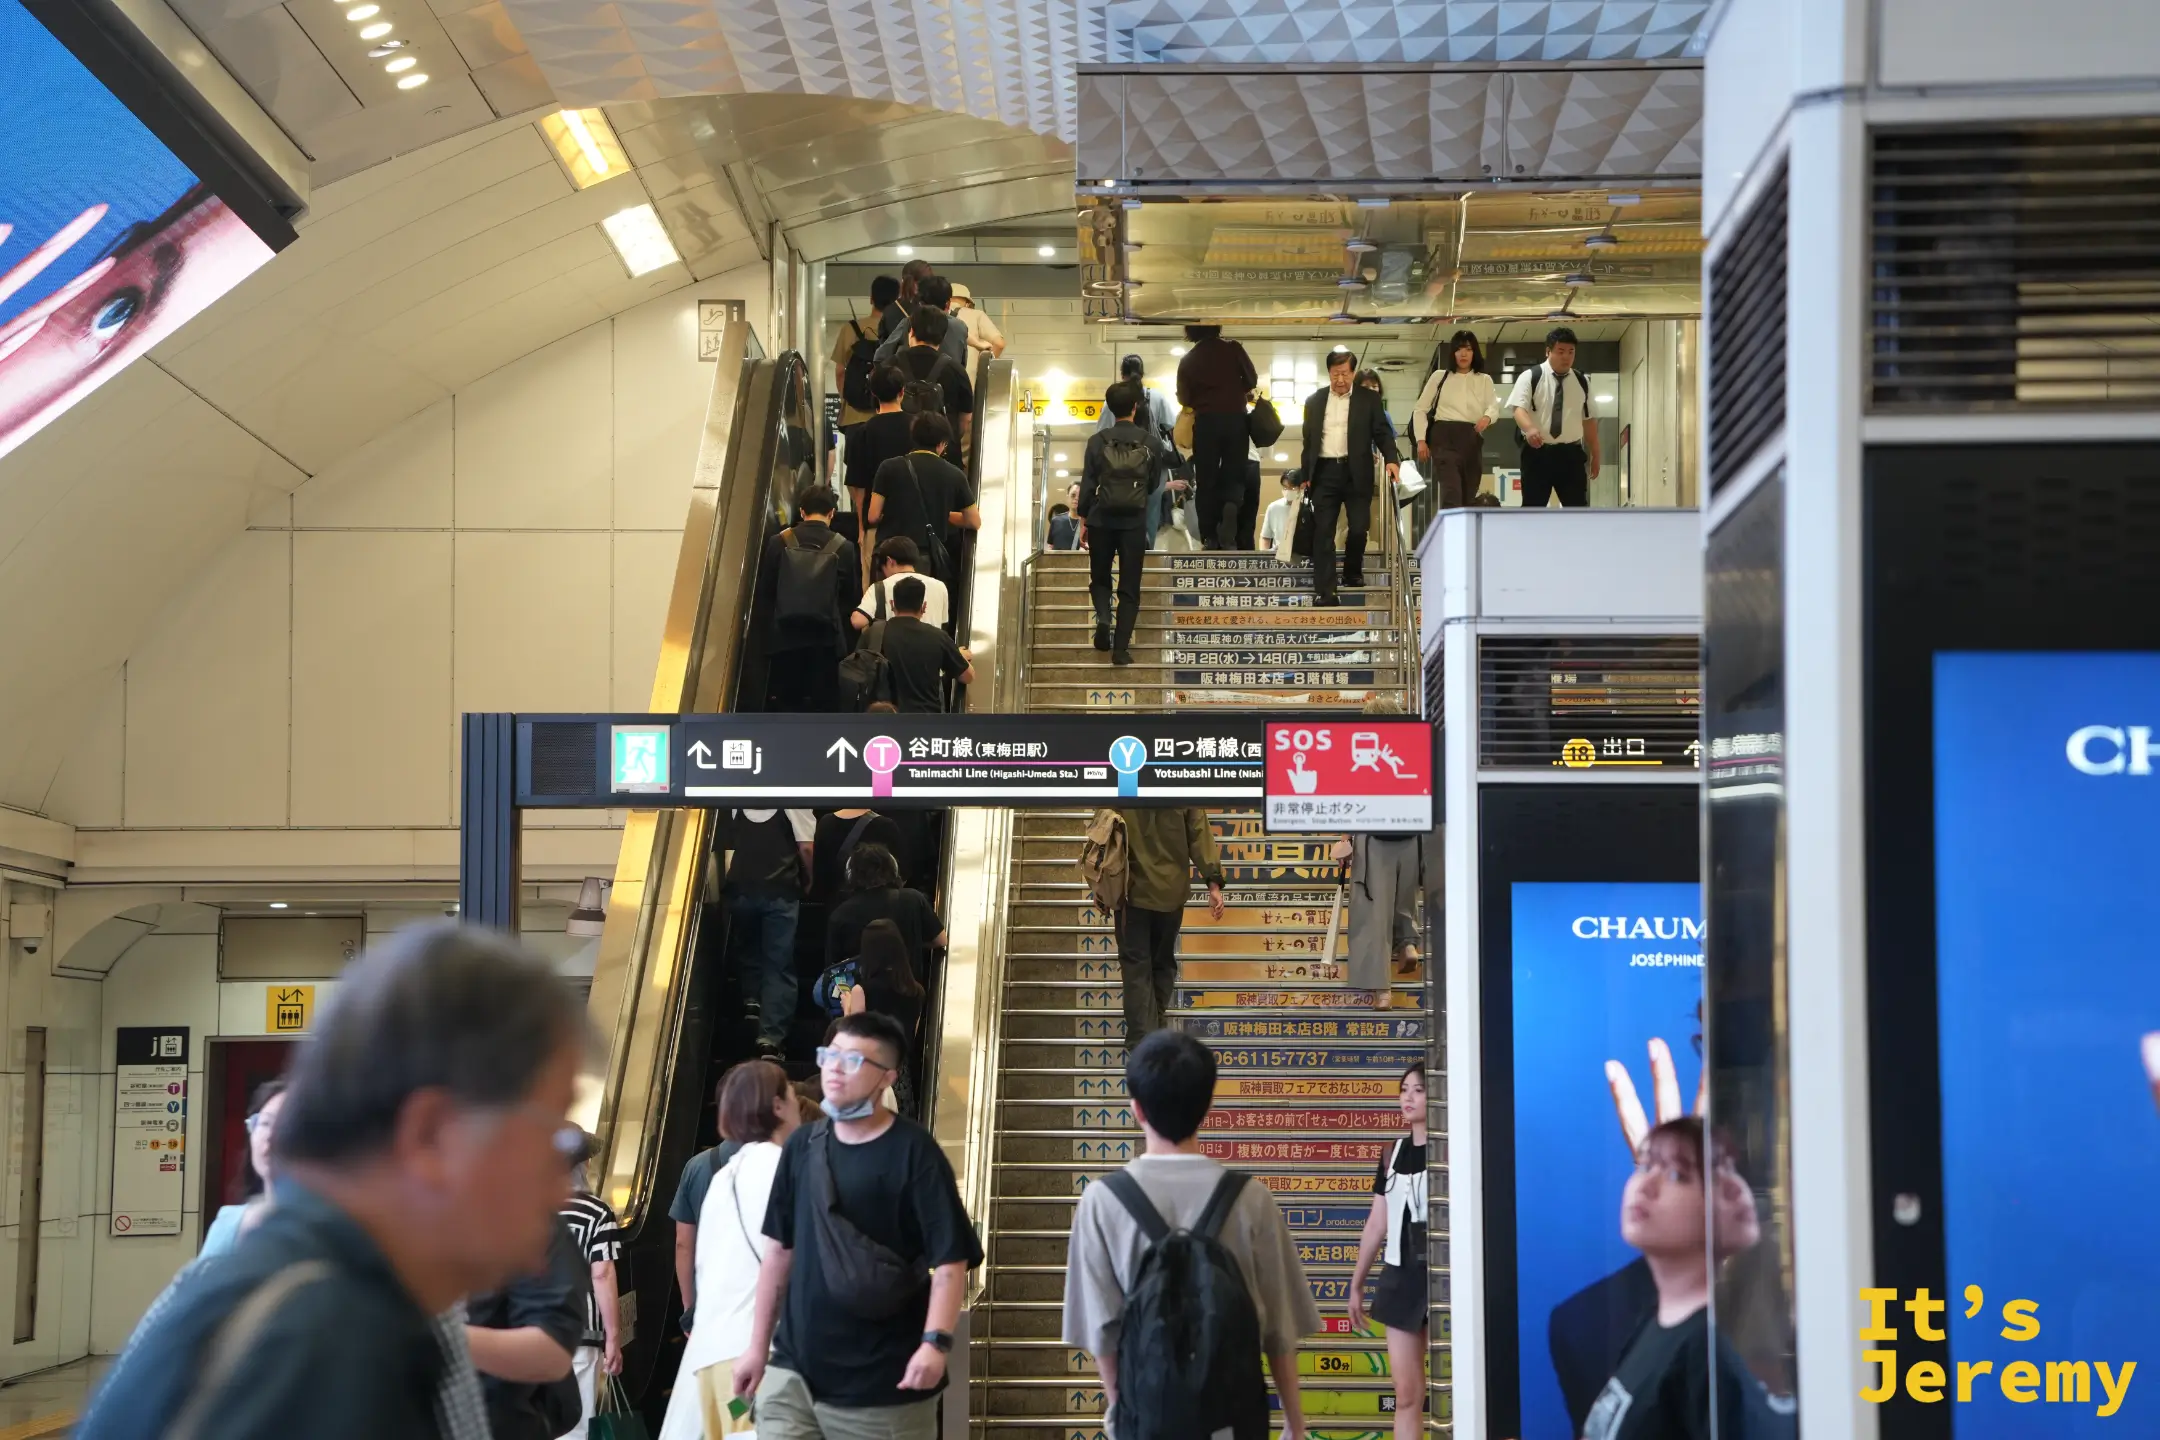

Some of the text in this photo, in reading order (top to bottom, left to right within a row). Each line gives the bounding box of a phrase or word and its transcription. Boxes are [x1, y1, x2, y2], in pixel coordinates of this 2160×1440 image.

[1085, 406, 1095, 416] 15
[1177, 577, 1194, 588] 9月
[1198, 577, 1235, 588] 2日(水)
[1254, 577, 1297, 588] 14日(月)
[1199, 595, 1280, 607] 阪神梅田本店
[1179, 652, 1196, 664] 9月
[1200, 651, 1239, 664] 2日(水)
[1258, 651, 1303, 664] 14日(月)
[1200, 672, 1349, 685] 阪神梅田本店 8階催場
[1274, 729, 1332, 751] SOS
[1602, 737, 1645, 756] 出口
[753, 747, 762, 774] j
[872, 743, 893, 767] T
[1118, 742, 1138, 768] Y
[908, 768, 1079, 779] Tanimachi Line (Higashi-Umeda Sta.)
[1154, 768, 1211, 779] Yotsubashi
[1214, 768, 1237, 779] Line
[1273, 802, 1367, 815] 非常停止ボタン
[1571, 916, 1708, 940] CHAUM
[1263, 936, 1326, 951] せぇーの買
[1629, 951, 1706, 968] JOSÉPHINE
[1235, 992, 1374, 1006] 阪神買取フェアでおなじみの
[1223, 1021, 1390, 1037] 阪神梅田本店8階 常設店
[150, 1036, 158, 1057] j
[1215, 1051, 1328, 1065] 06-6115-7737
[1239, 1080, 1383, 1095] 阪神買取フェアでおなじみの
[1237, 1143, 1382, 1160] 複数の質店が一度に査定
[1279, 1209, 1323, 1226] ロン
[1326, 1217, 1366, 1230] produced
[1299, 1244, 1360, 1262] 本店8階
[1320, 1357, 1350, 1371] 30分
